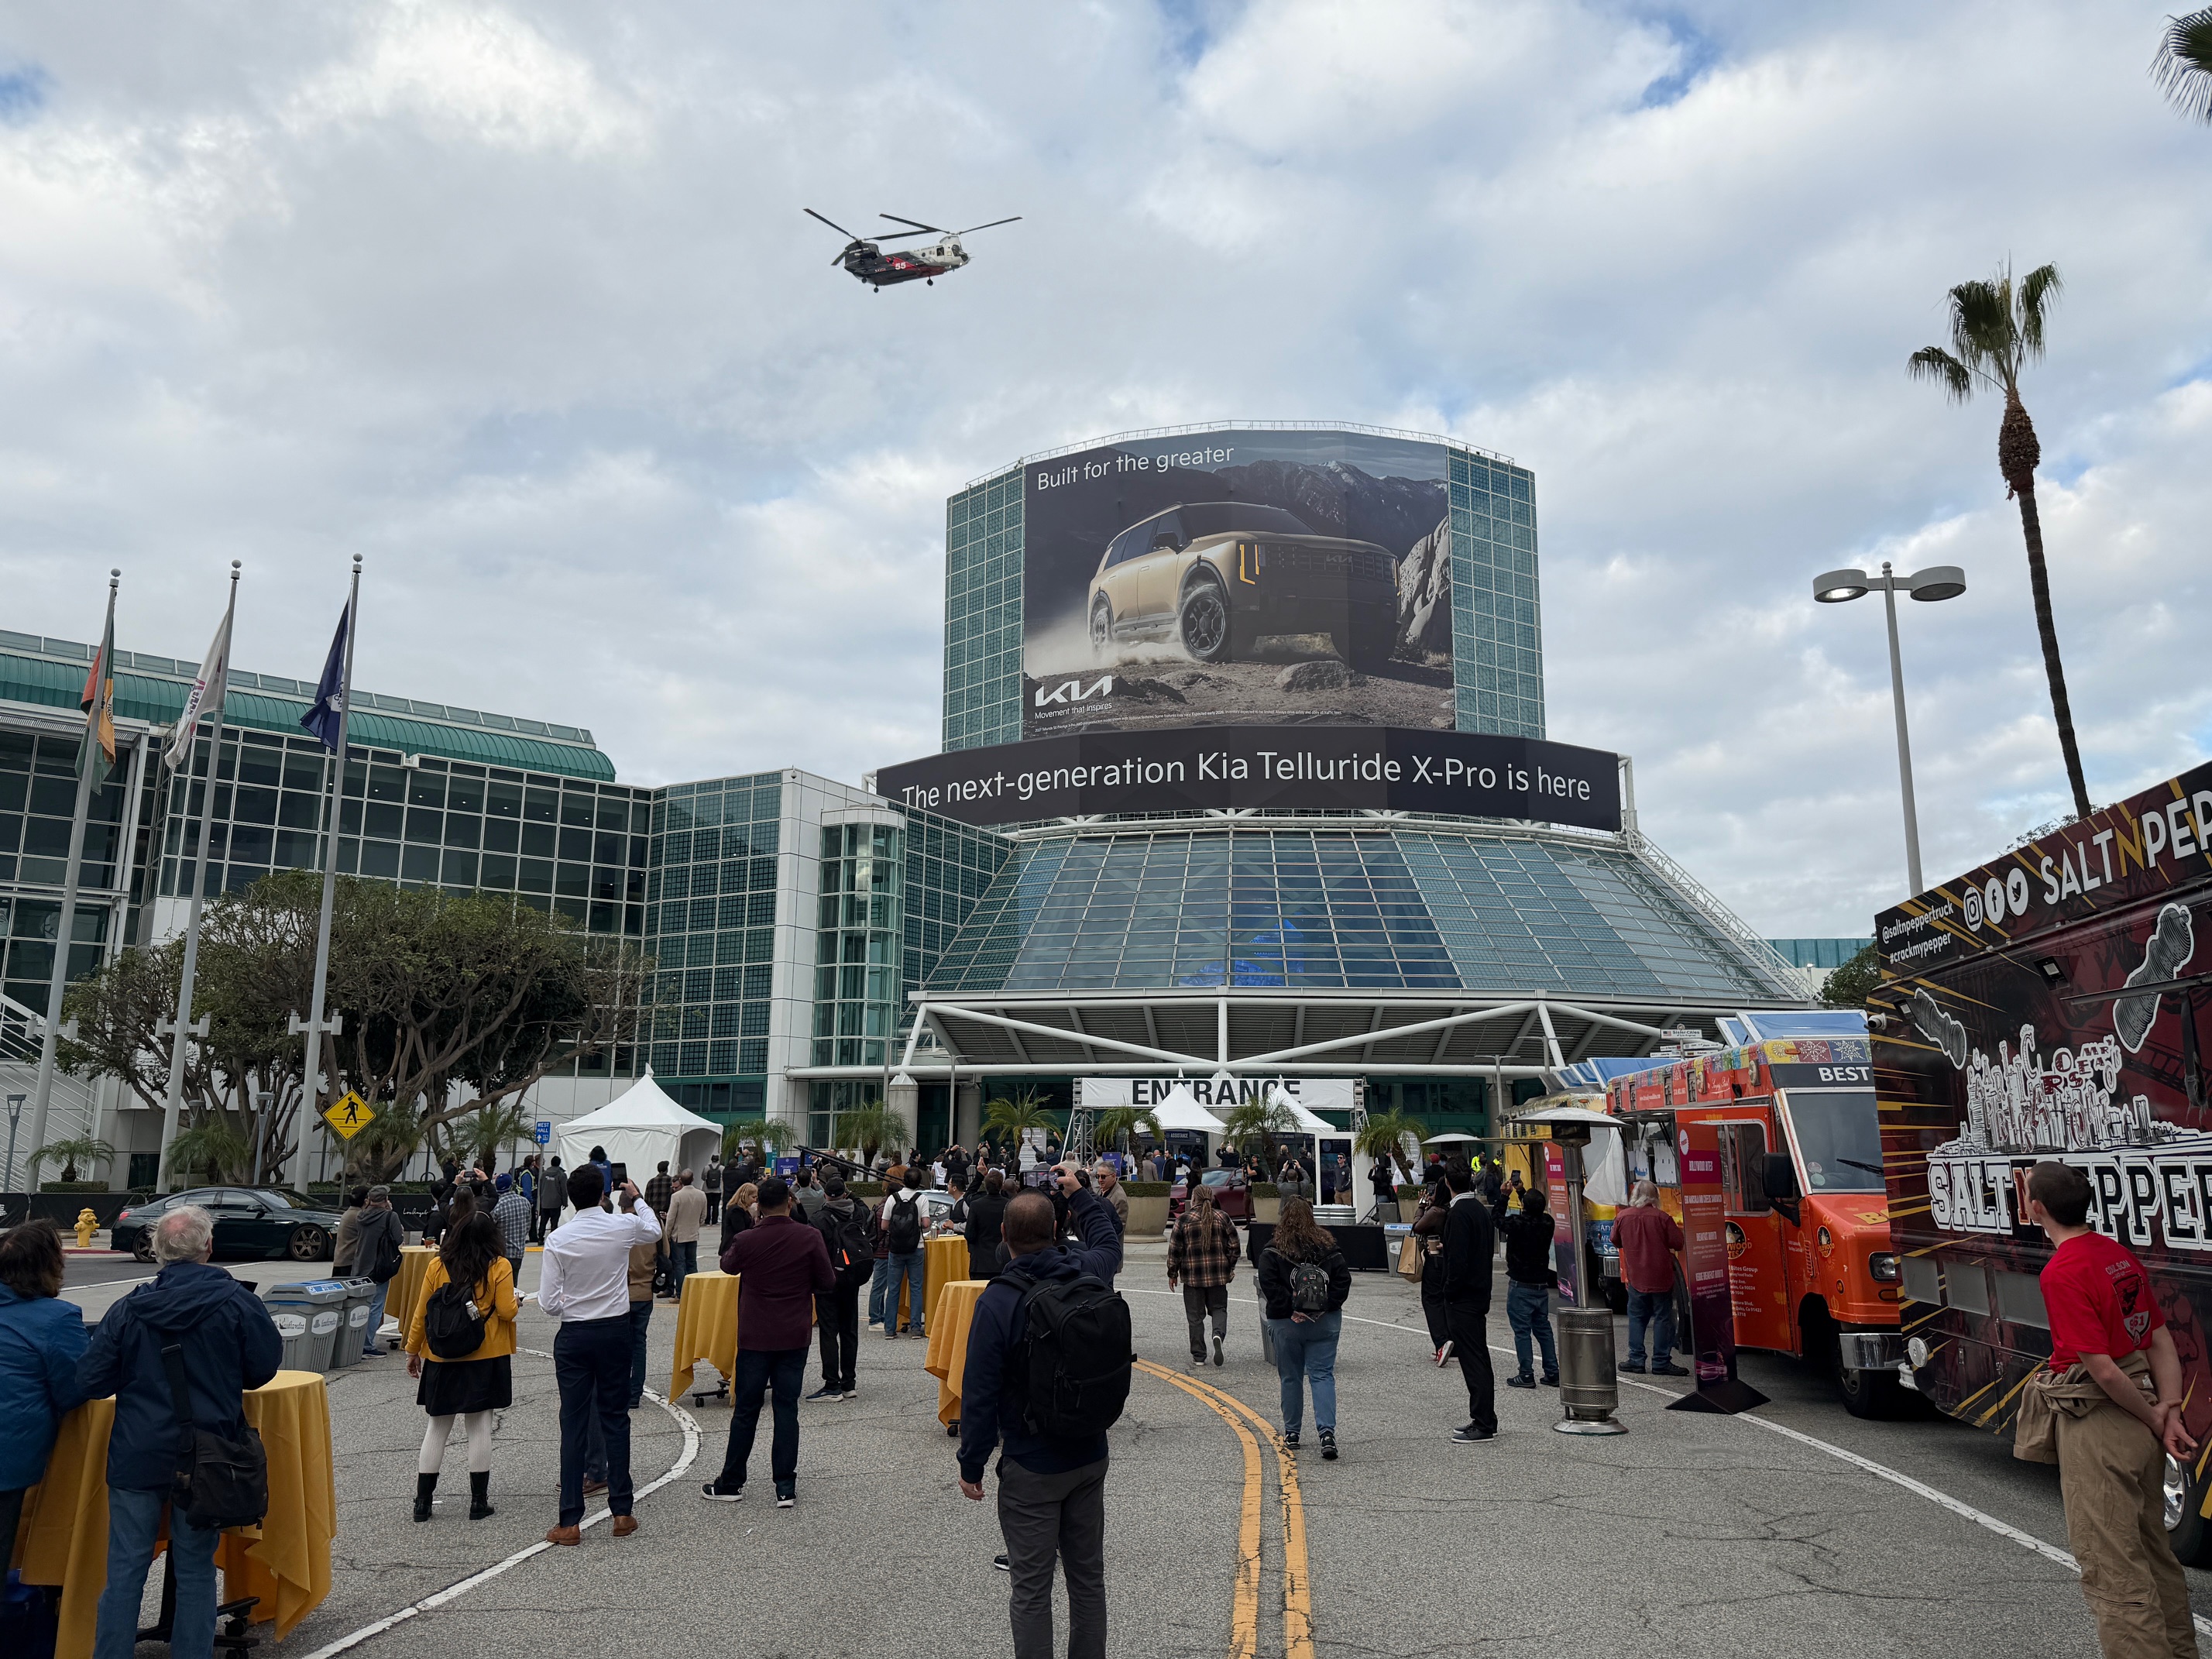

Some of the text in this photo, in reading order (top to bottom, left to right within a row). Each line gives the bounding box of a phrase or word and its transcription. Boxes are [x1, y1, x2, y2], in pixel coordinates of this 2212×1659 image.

[895, 262, 906, 270] 55
[1038, 447, 1235, 490] Built for the greater
[1035, 707, 1070, 720] Movement
[1071, 705, 1085, 715] that
[902, 751, 1591, 809] The next-generation Kia Telluride X-Pro is here
[1882, 897, 1954, 944] @saltnpeppertruck
[1890, 932, 1951, 965] #crackmypepper
[1818, 1066, 1870, 1082] BEST
[1602, 1244, 1620, 1255] Se
